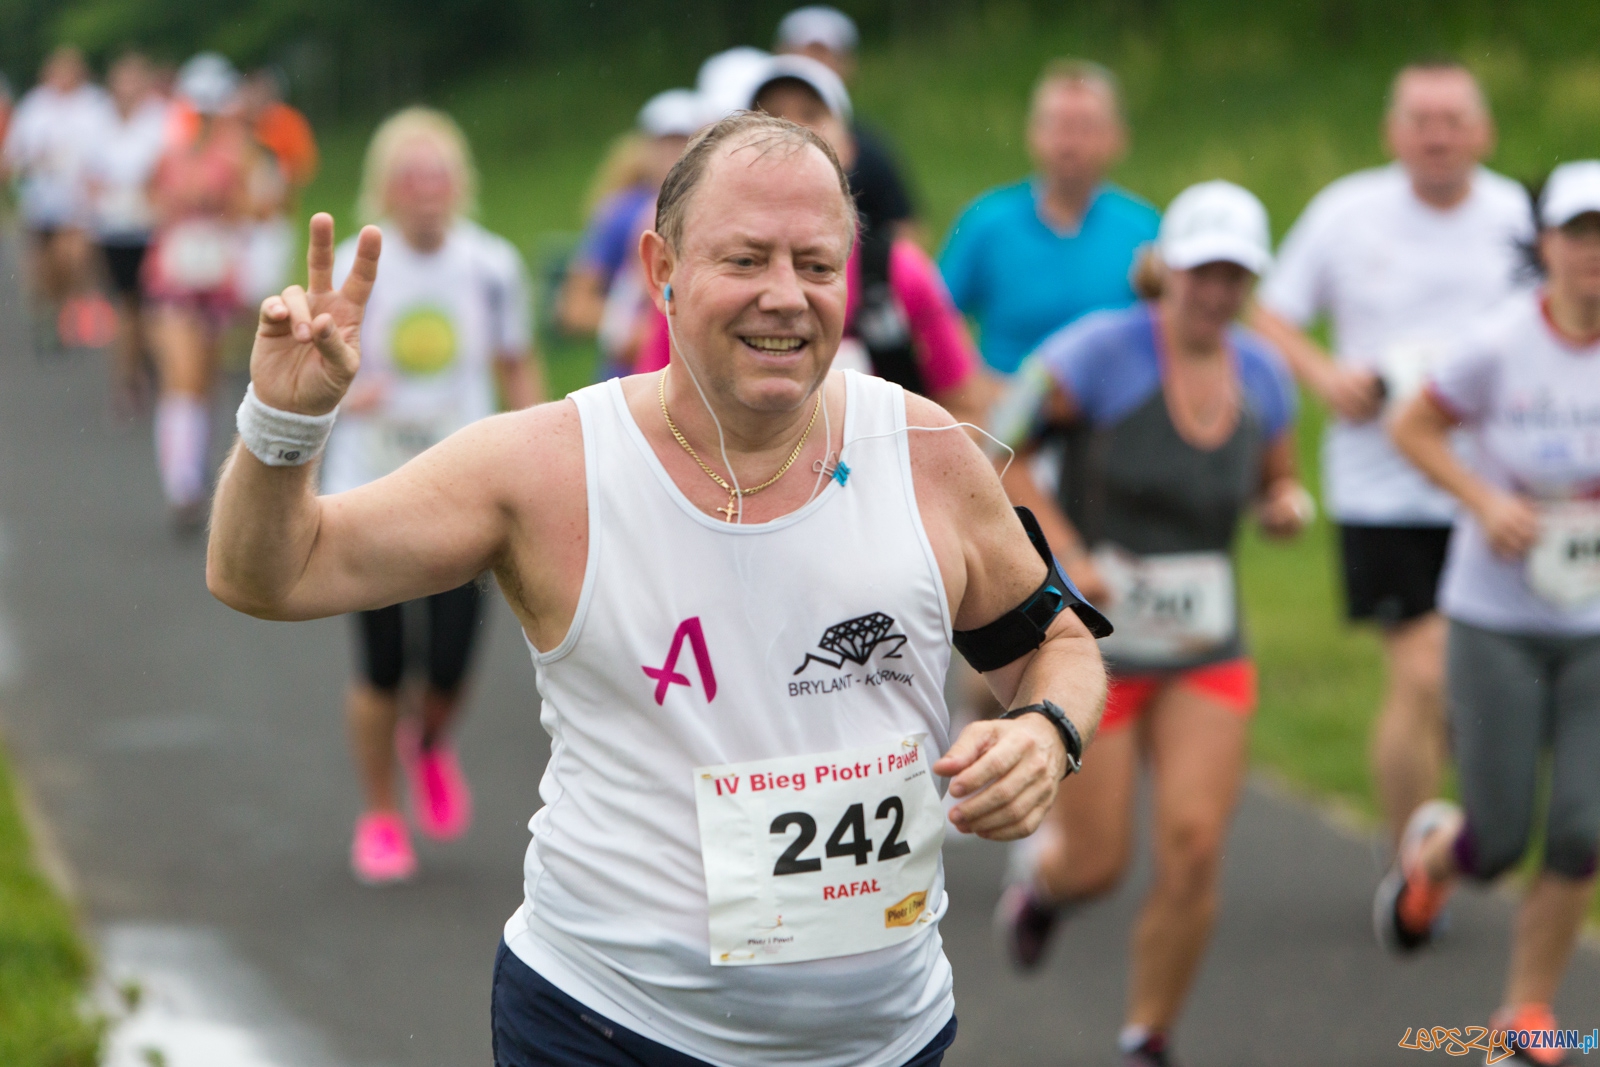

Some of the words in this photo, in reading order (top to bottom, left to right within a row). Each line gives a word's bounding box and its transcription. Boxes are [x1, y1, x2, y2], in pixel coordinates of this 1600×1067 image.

[788, 674, 853, 697] BRYLANT
[714, 776, 740, 796] IV
[750, 772, 806, 792] Bieg
[815, 763, 871, 784] Piotr
[877, 757, 882, 774] i
[888, 745, 918, 772] Paweł
[769, 795, 911, 876] 242
[823, 878, 881, 901] RAFAŁ
[888, 907, 908, 922] Piotr
